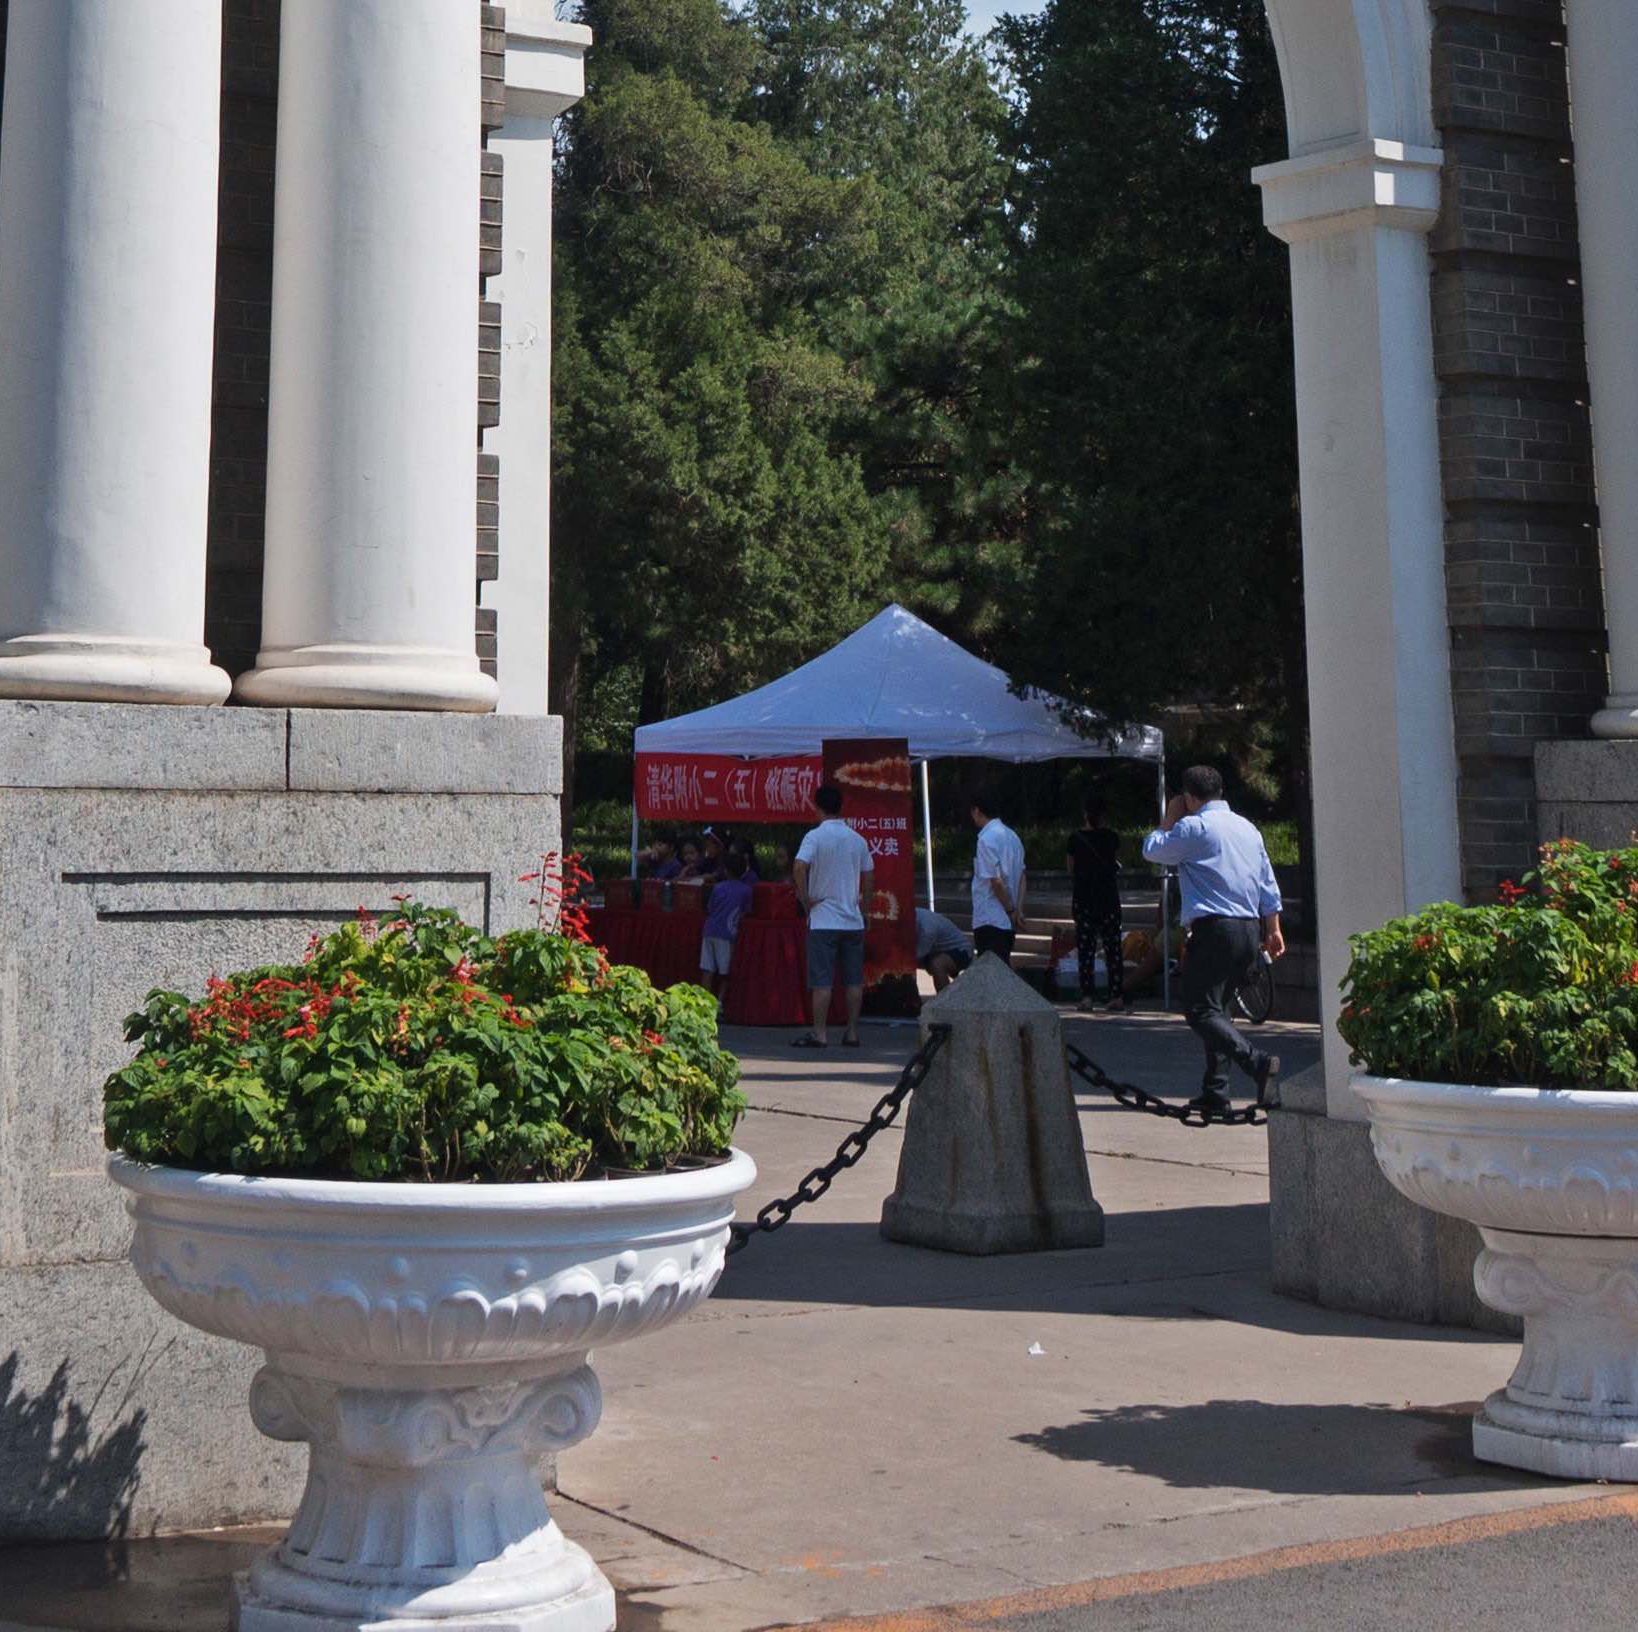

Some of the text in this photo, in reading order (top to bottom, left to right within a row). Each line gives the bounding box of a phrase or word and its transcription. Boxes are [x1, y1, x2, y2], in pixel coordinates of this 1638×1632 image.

[646, 763, 824, 811] 清华附小二（五）班赈灾
